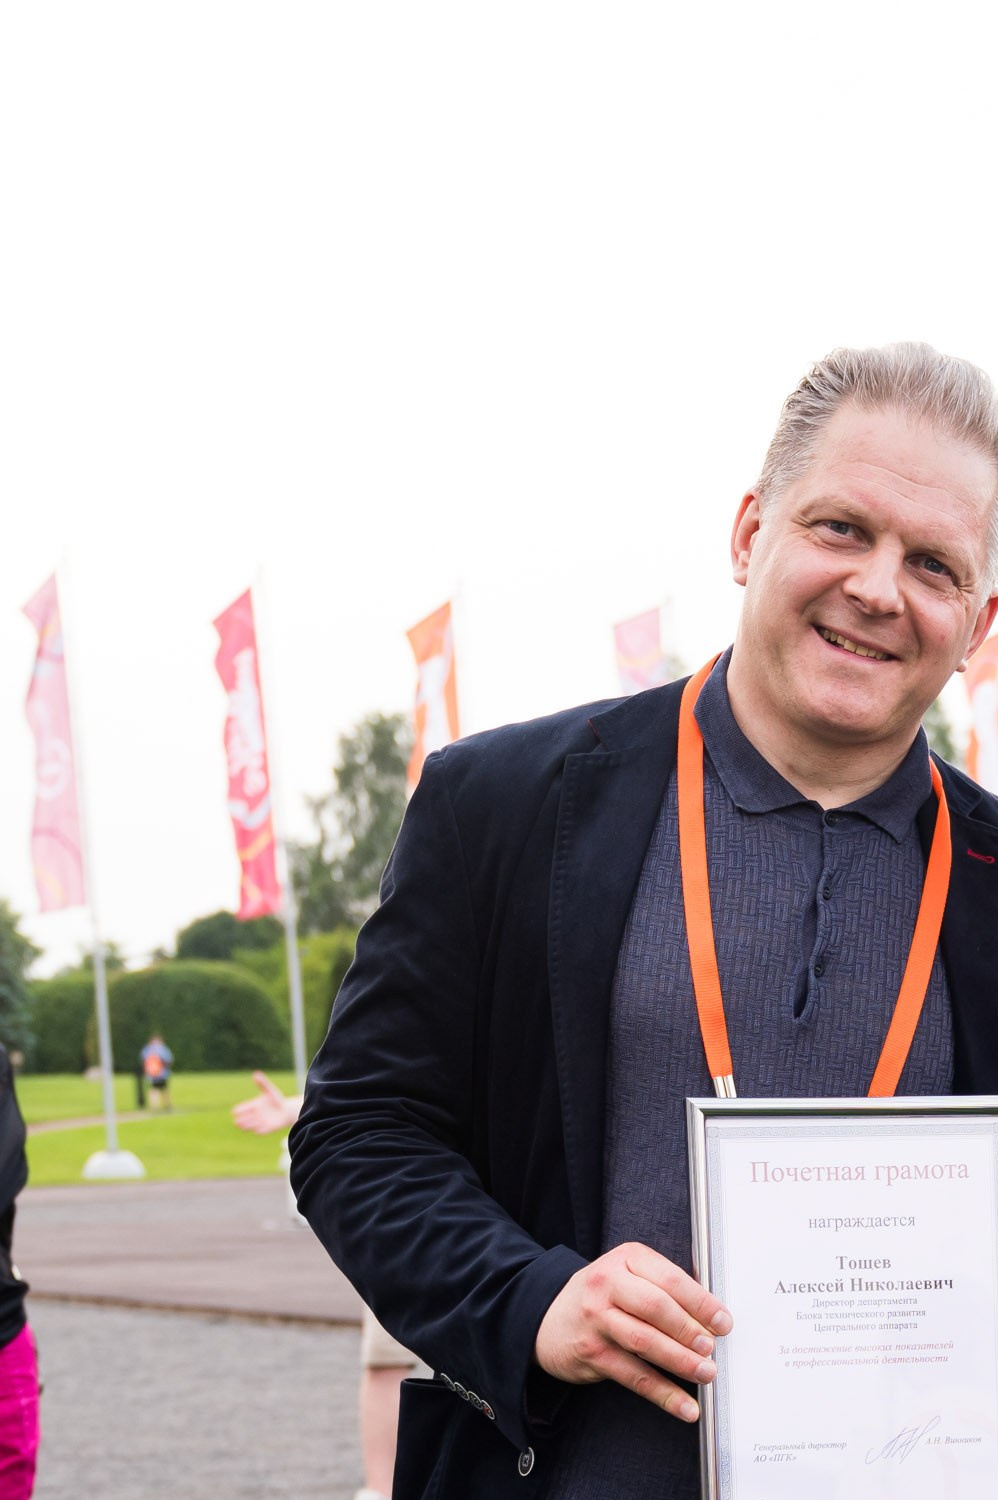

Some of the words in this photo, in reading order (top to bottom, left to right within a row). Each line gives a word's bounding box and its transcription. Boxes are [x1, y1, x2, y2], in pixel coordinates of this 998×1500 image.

[750, 1161, 866, 1183] Почетная
[873, 1163, 970, 1186] грамота
[808, 1215, 916, 1232] награждается
[836, 1256, 892, 1271] Тощев
[774, 1278, 844, 1294] Алексей
[850, 1277, 954, 1292] Николаевич
[812, 1298, 855, 1309] Директор
[857, 1297, 918, 1308] департамента
[796, 1311, 823, 1321] Блока
[825, 1311, 885, 1320] технического
[887, 1309, 926, 1320] развития
[814, 1322, 876, 1334] Центрального
[878, 1321, 918, 1332] аппарата
[778, 1345, 790, 1355] За
[791, 1343, 852, 1355] достижение
[854, 1343, 893, 1353] высоких
[895, 1340, 955, 1352] показателей
[792, 1356, 879, 1369] профессиональной
[881, 1354, 948, 1366] деятельности
[753, 1442, 806, 1452] Генеральный
[807, 1441, 848, 1452] директор
[753, 1454, 767, 1463] АО
[768, 1453, 798, 1463] «ПГК»
